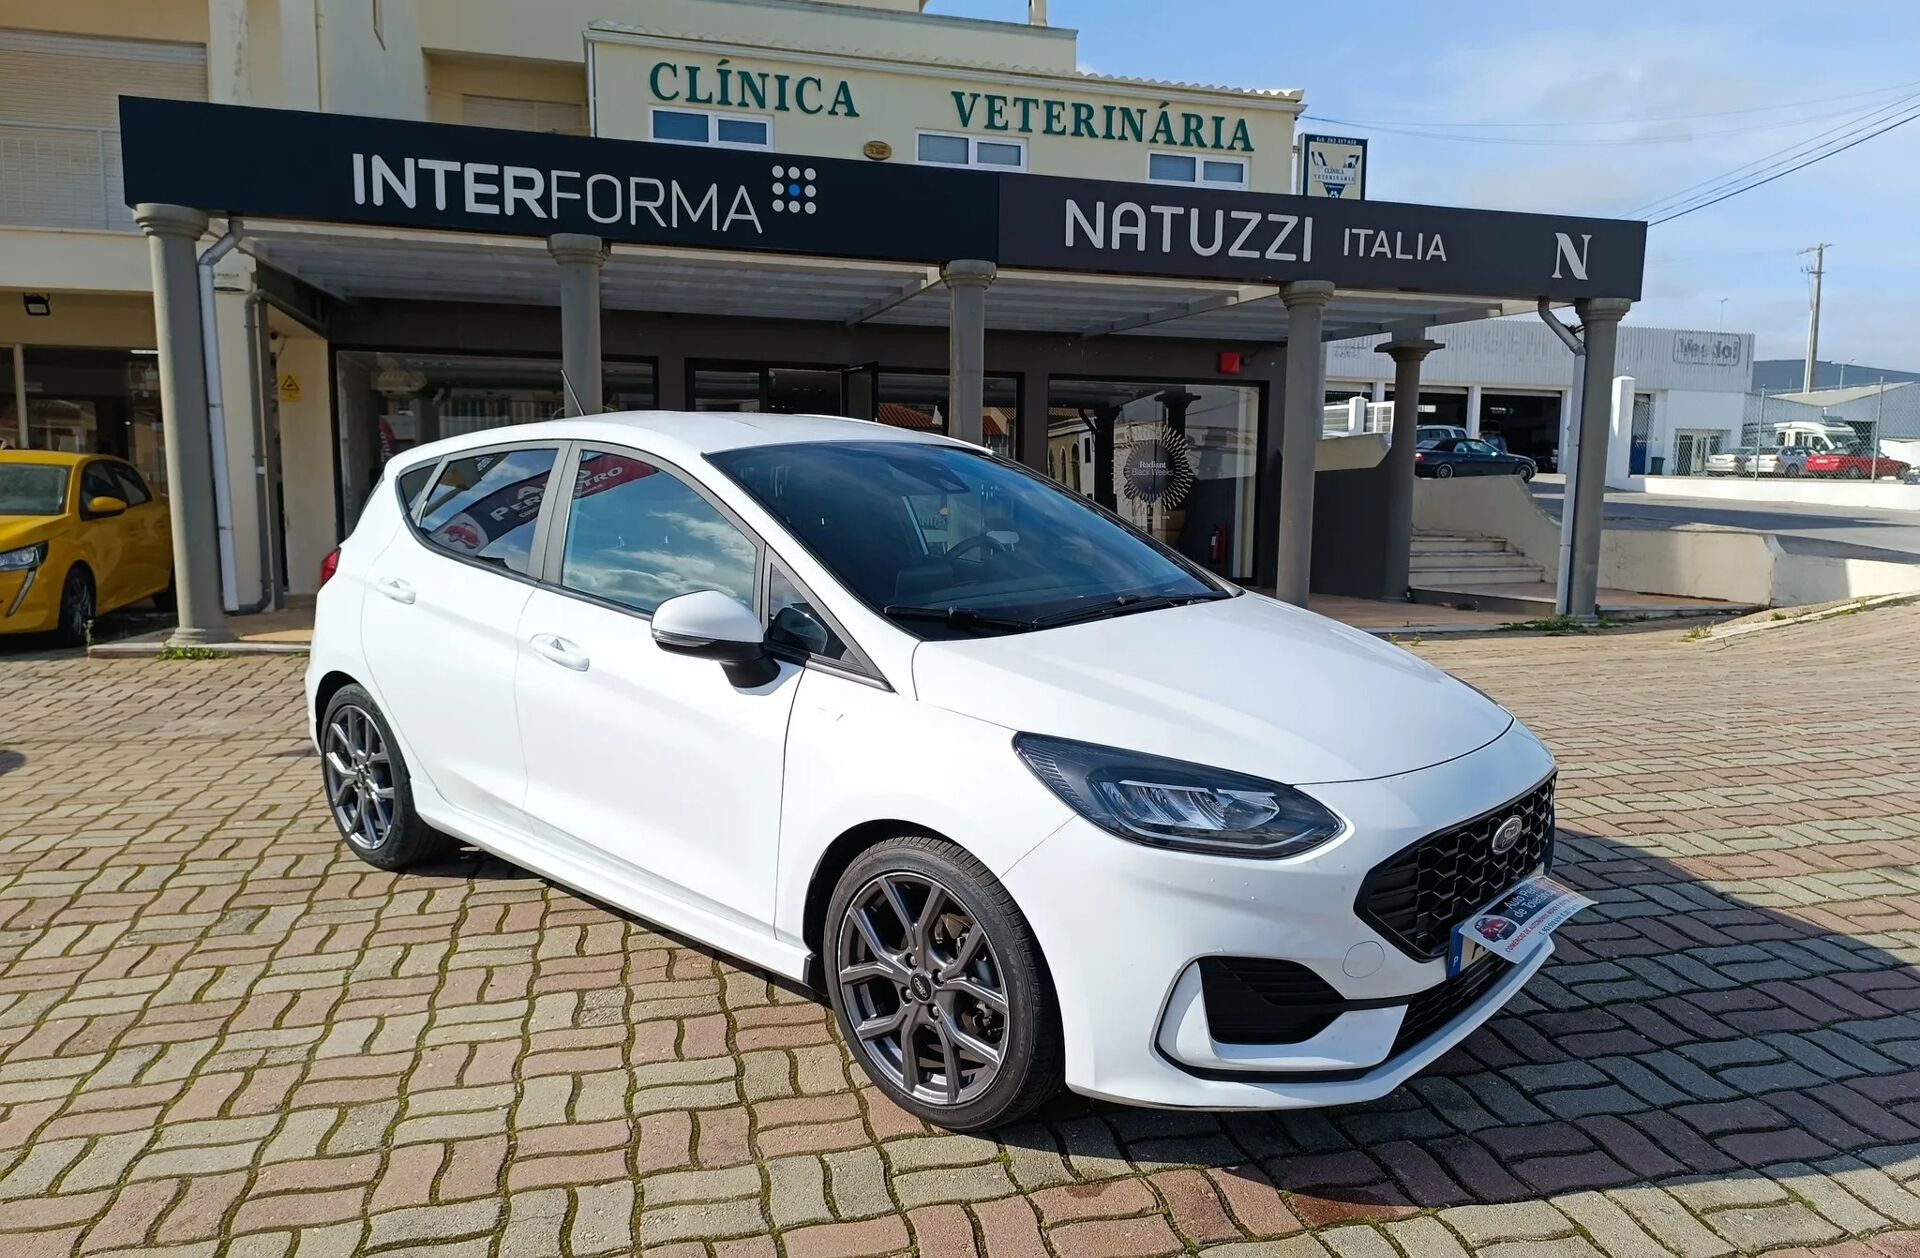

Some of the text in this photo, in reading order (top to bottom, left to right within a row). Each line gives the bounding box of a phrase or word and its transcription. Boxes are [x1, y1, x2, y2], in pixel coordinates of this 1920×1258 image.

[650, 58, 1255, 153] CLÍNICA VETERINÁRIA
[352, 152, 763, 235] INTERFORMA
[1065, 198, 1448, 263] NATUZZI ITALIA
[1551, 232, 1593, 281] N
